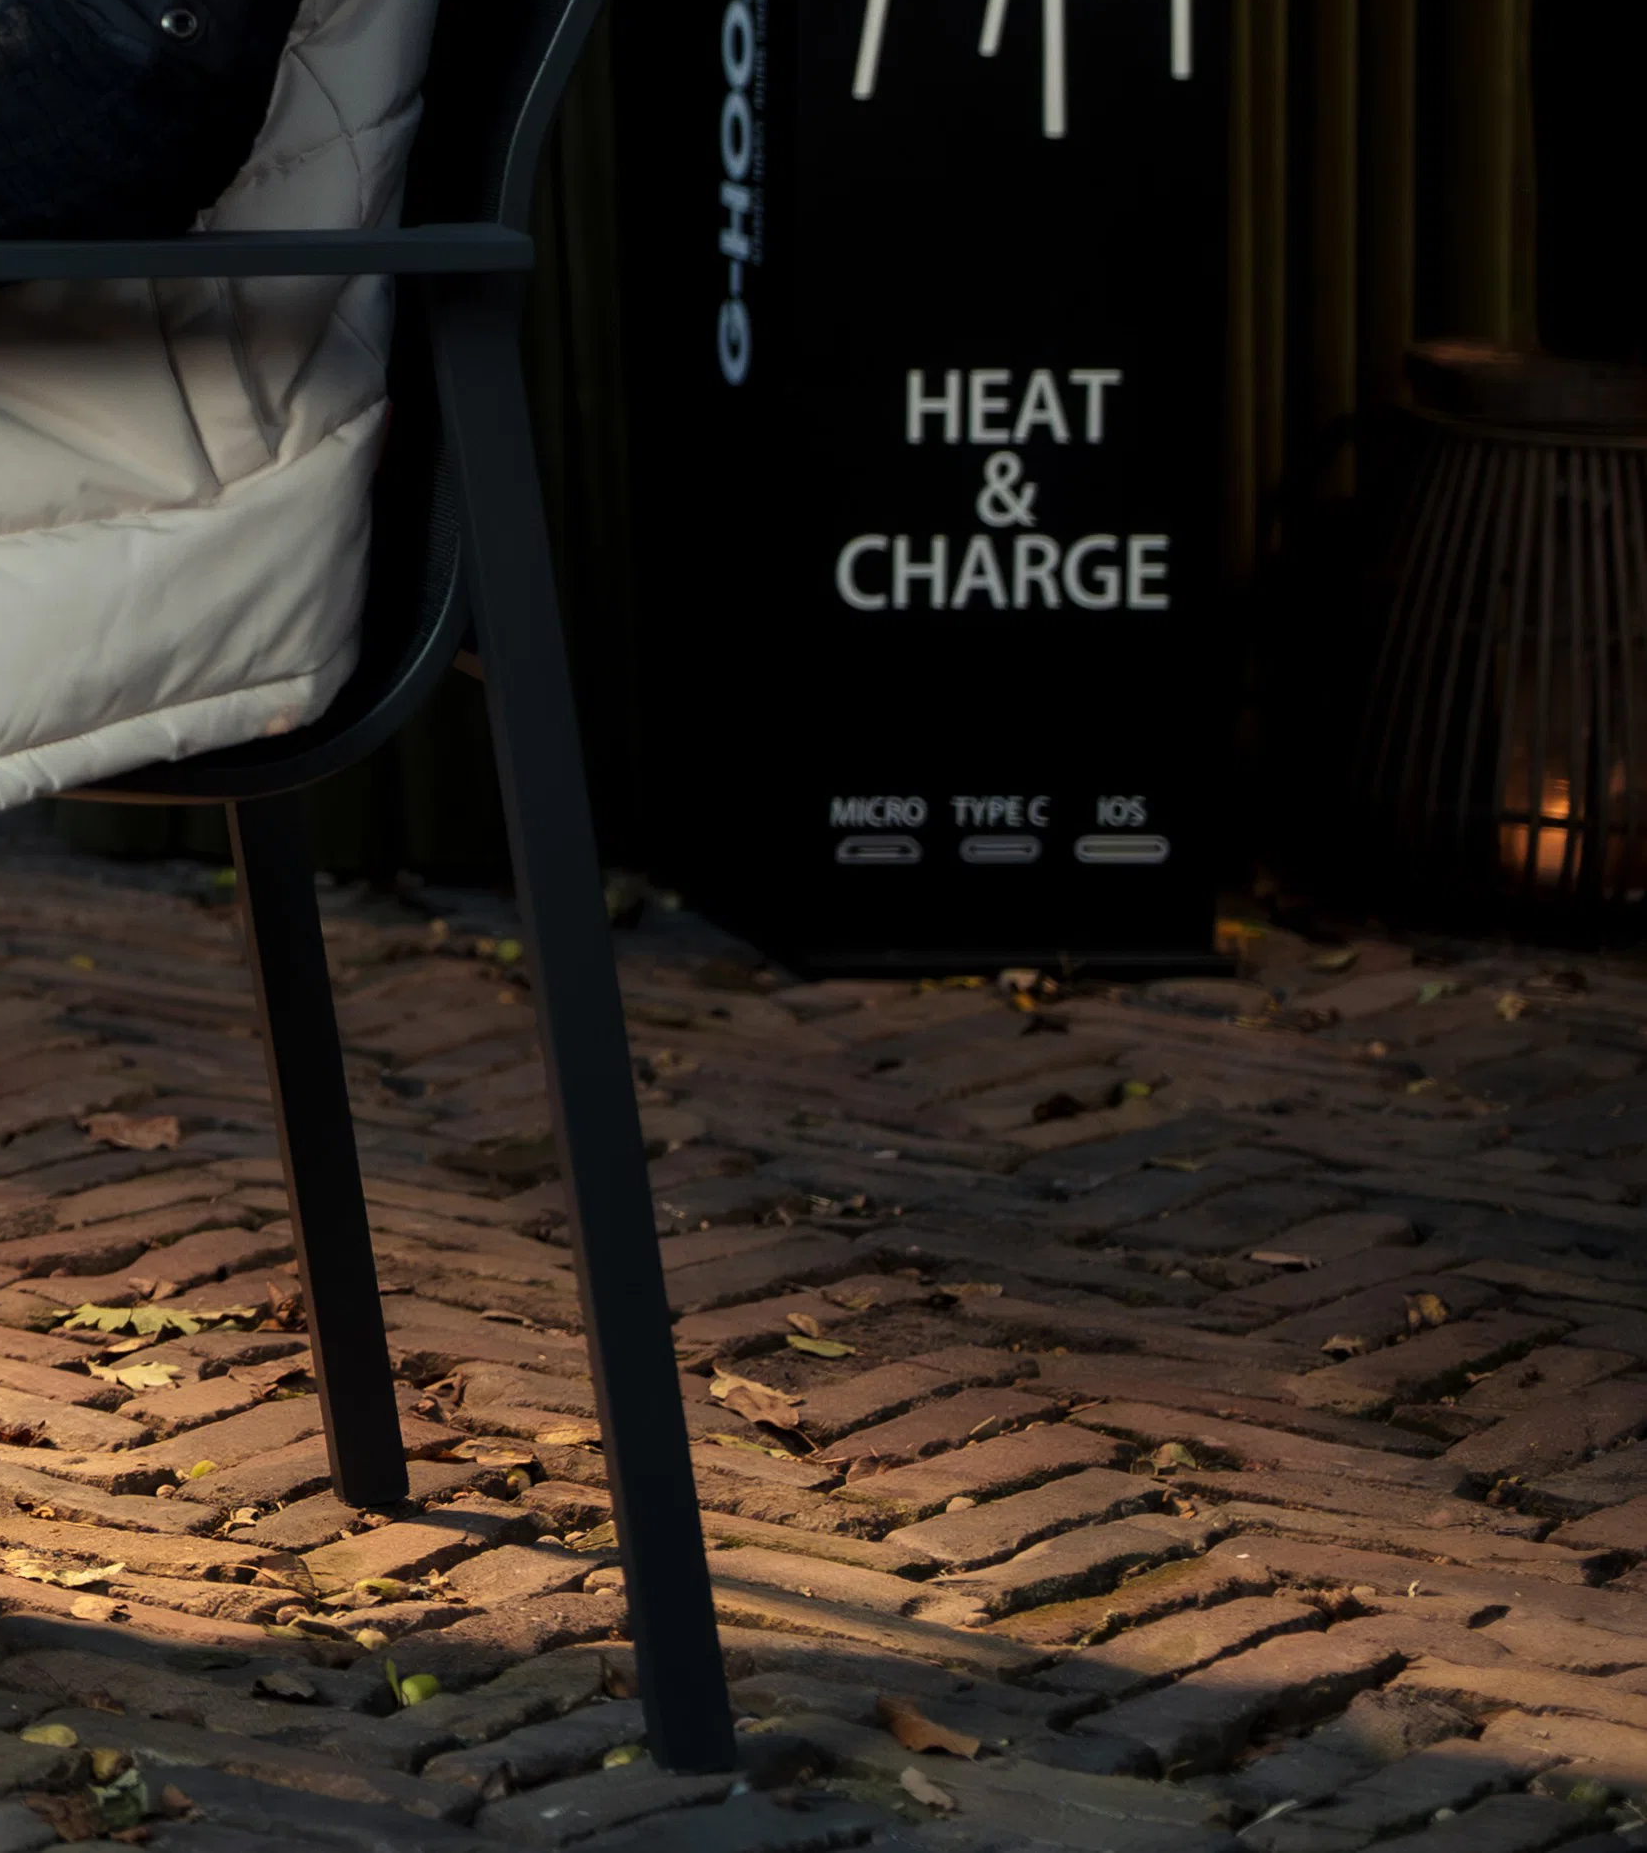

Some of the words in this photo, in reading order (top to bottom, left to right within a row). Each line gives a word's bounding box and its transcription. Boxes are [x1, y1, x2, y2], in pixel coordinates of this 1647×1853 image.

[905, 368, 1123, 445] HEAT
[976, 450, 1037, 528] &
[835, 533, 1170, 611] CHARGE
[829, 796, 927, 827] MICRO
[951, 796, 1025, 827] TYPE
[1028, 796, 1051, 827] C
[1096, 796, 1146, 827] IOS
